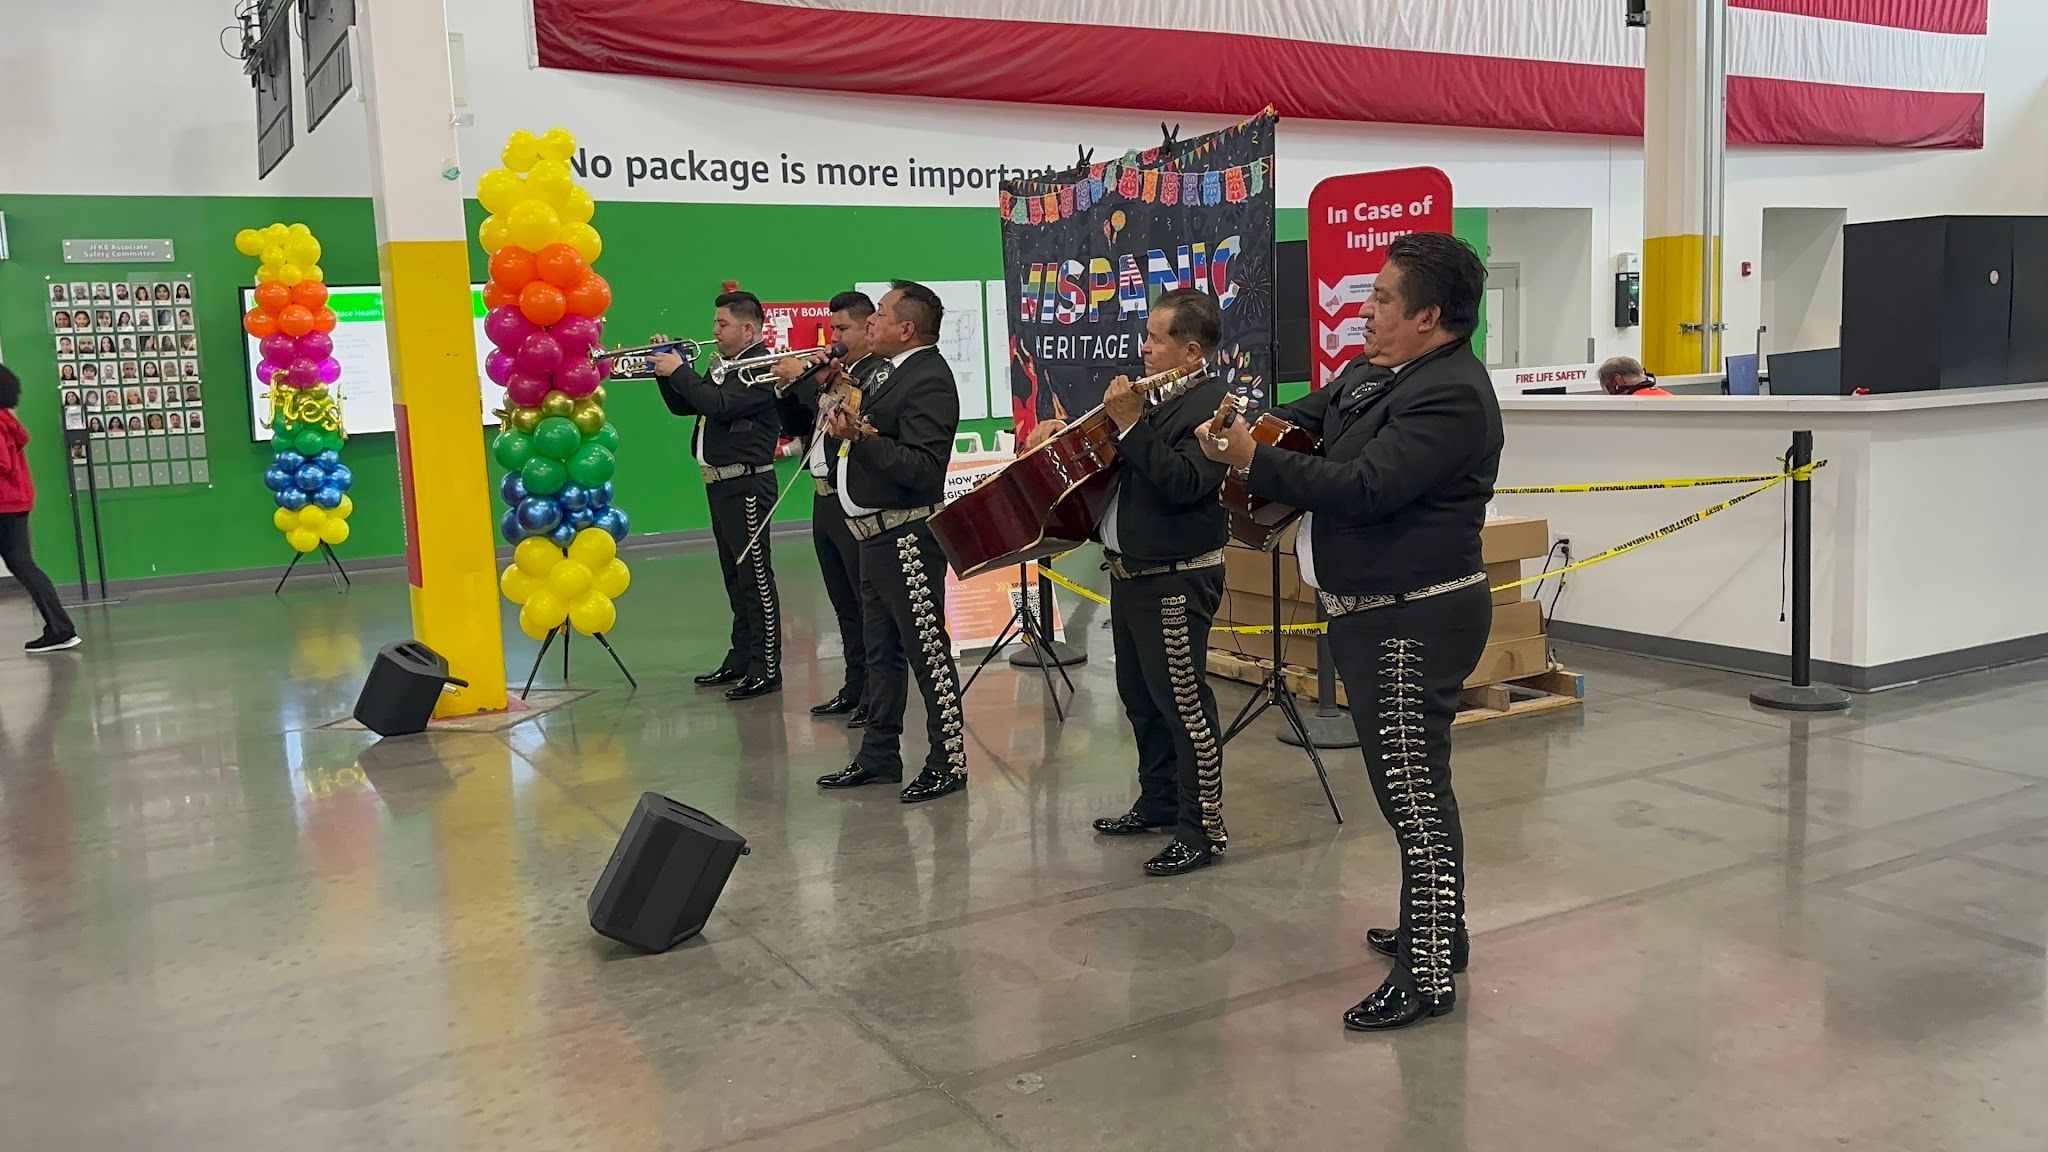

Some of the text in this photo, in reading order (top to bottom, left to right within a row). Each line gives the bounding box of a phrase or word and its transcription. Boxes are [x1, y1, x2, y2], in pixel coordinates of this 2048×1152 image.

[570, 147, 612, 178] No
[626, 149, 769, 191] package
[780, 153, 806, 184] is
[817, 162, 898, 187] more
[1327, 194, 1433, 225] In Case of
[111, 243, 149, 251] Associate
[83, 250, 156, 259] Safety Committee
[1021, 235, 1242, 325] HISPANIC
[762, 307, 833, 317] AFETY BOAR
[1035, 333, 1130, 360] HERITAGE
[1516, 370, 1587, 384] FIRE LIFE SAFETY
[948, 475, 972, 486] HOW
[1011, 580, 1038, 589] SPISH
